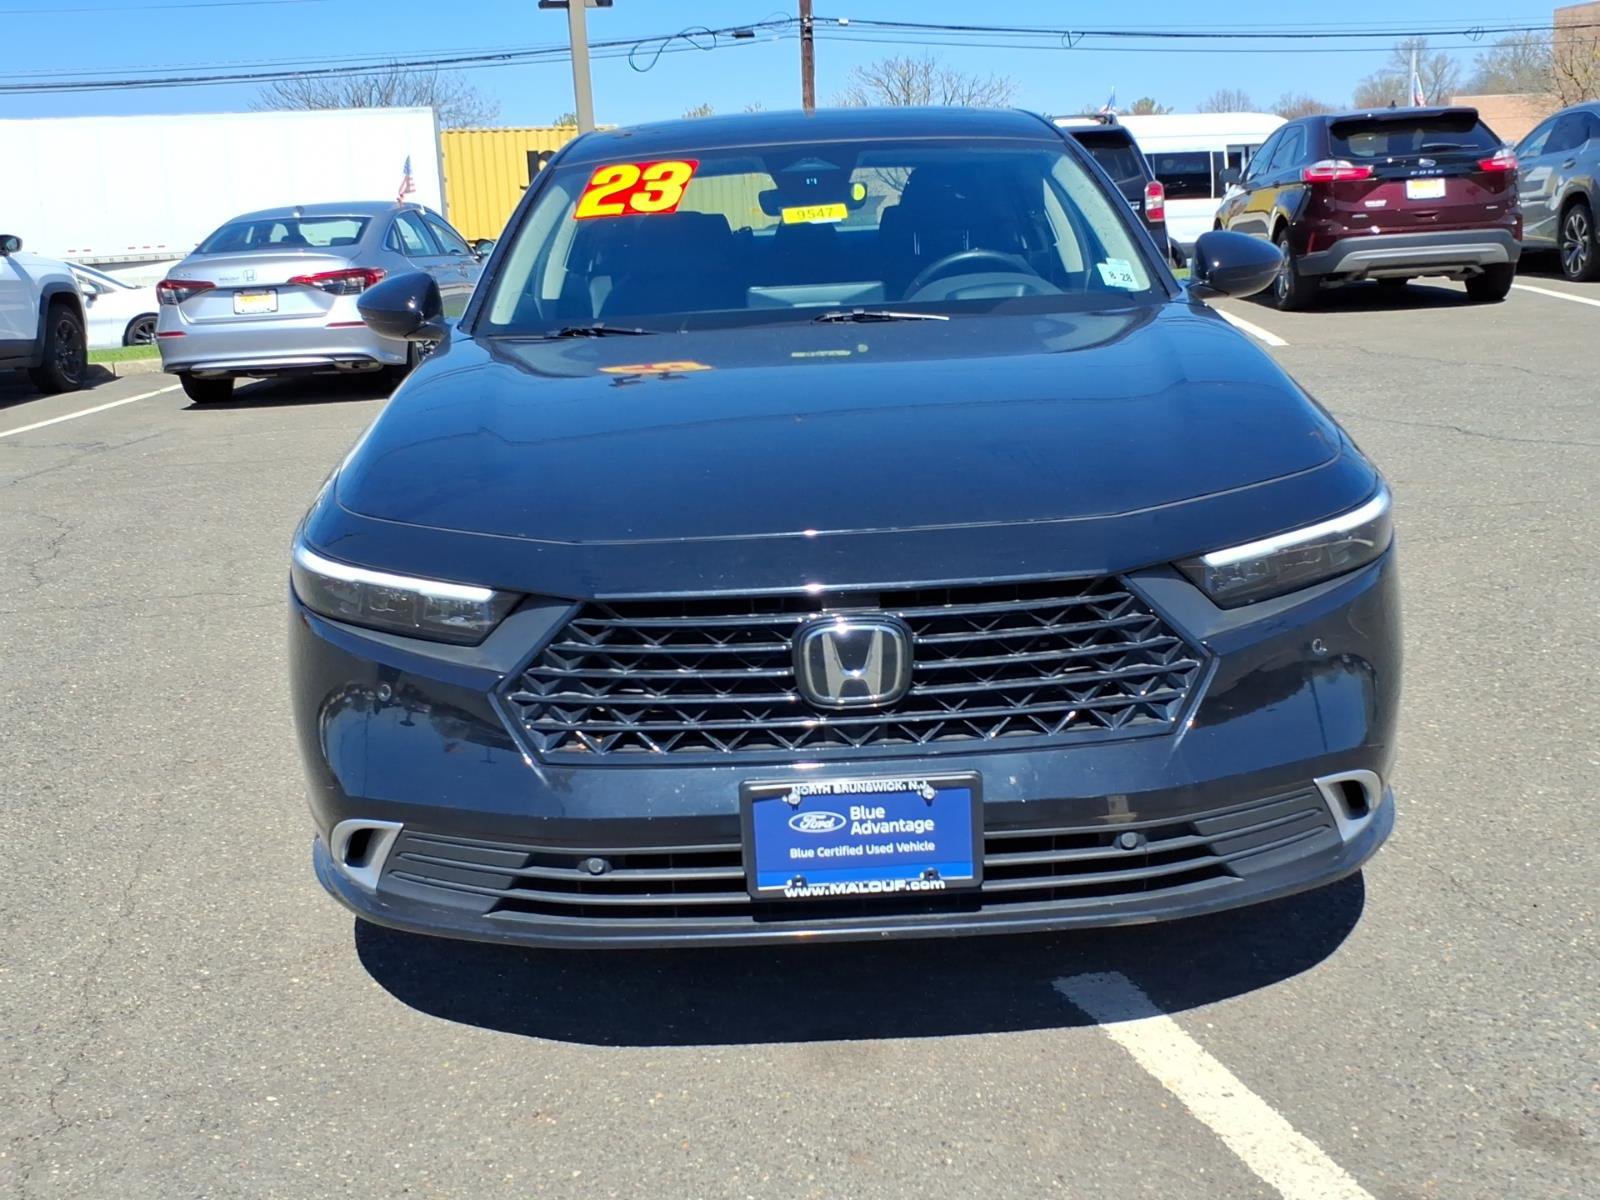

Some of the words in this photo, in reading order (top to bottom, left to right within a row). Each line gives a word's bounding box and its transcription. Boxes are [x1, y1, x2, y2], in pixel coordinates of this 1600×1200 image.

[575, 161, 692, 217] 23
[796, 207, 833, 220] 9547
[850, 805, 885, 820] Blue
[850, 819, 935, 836] Advantage
[790, 848, 815, 859] Blue
[817, 845, 864, 858] Certified
[866, 843, 894, 855] Used
[896, 840, 936, 853] Vehicle
